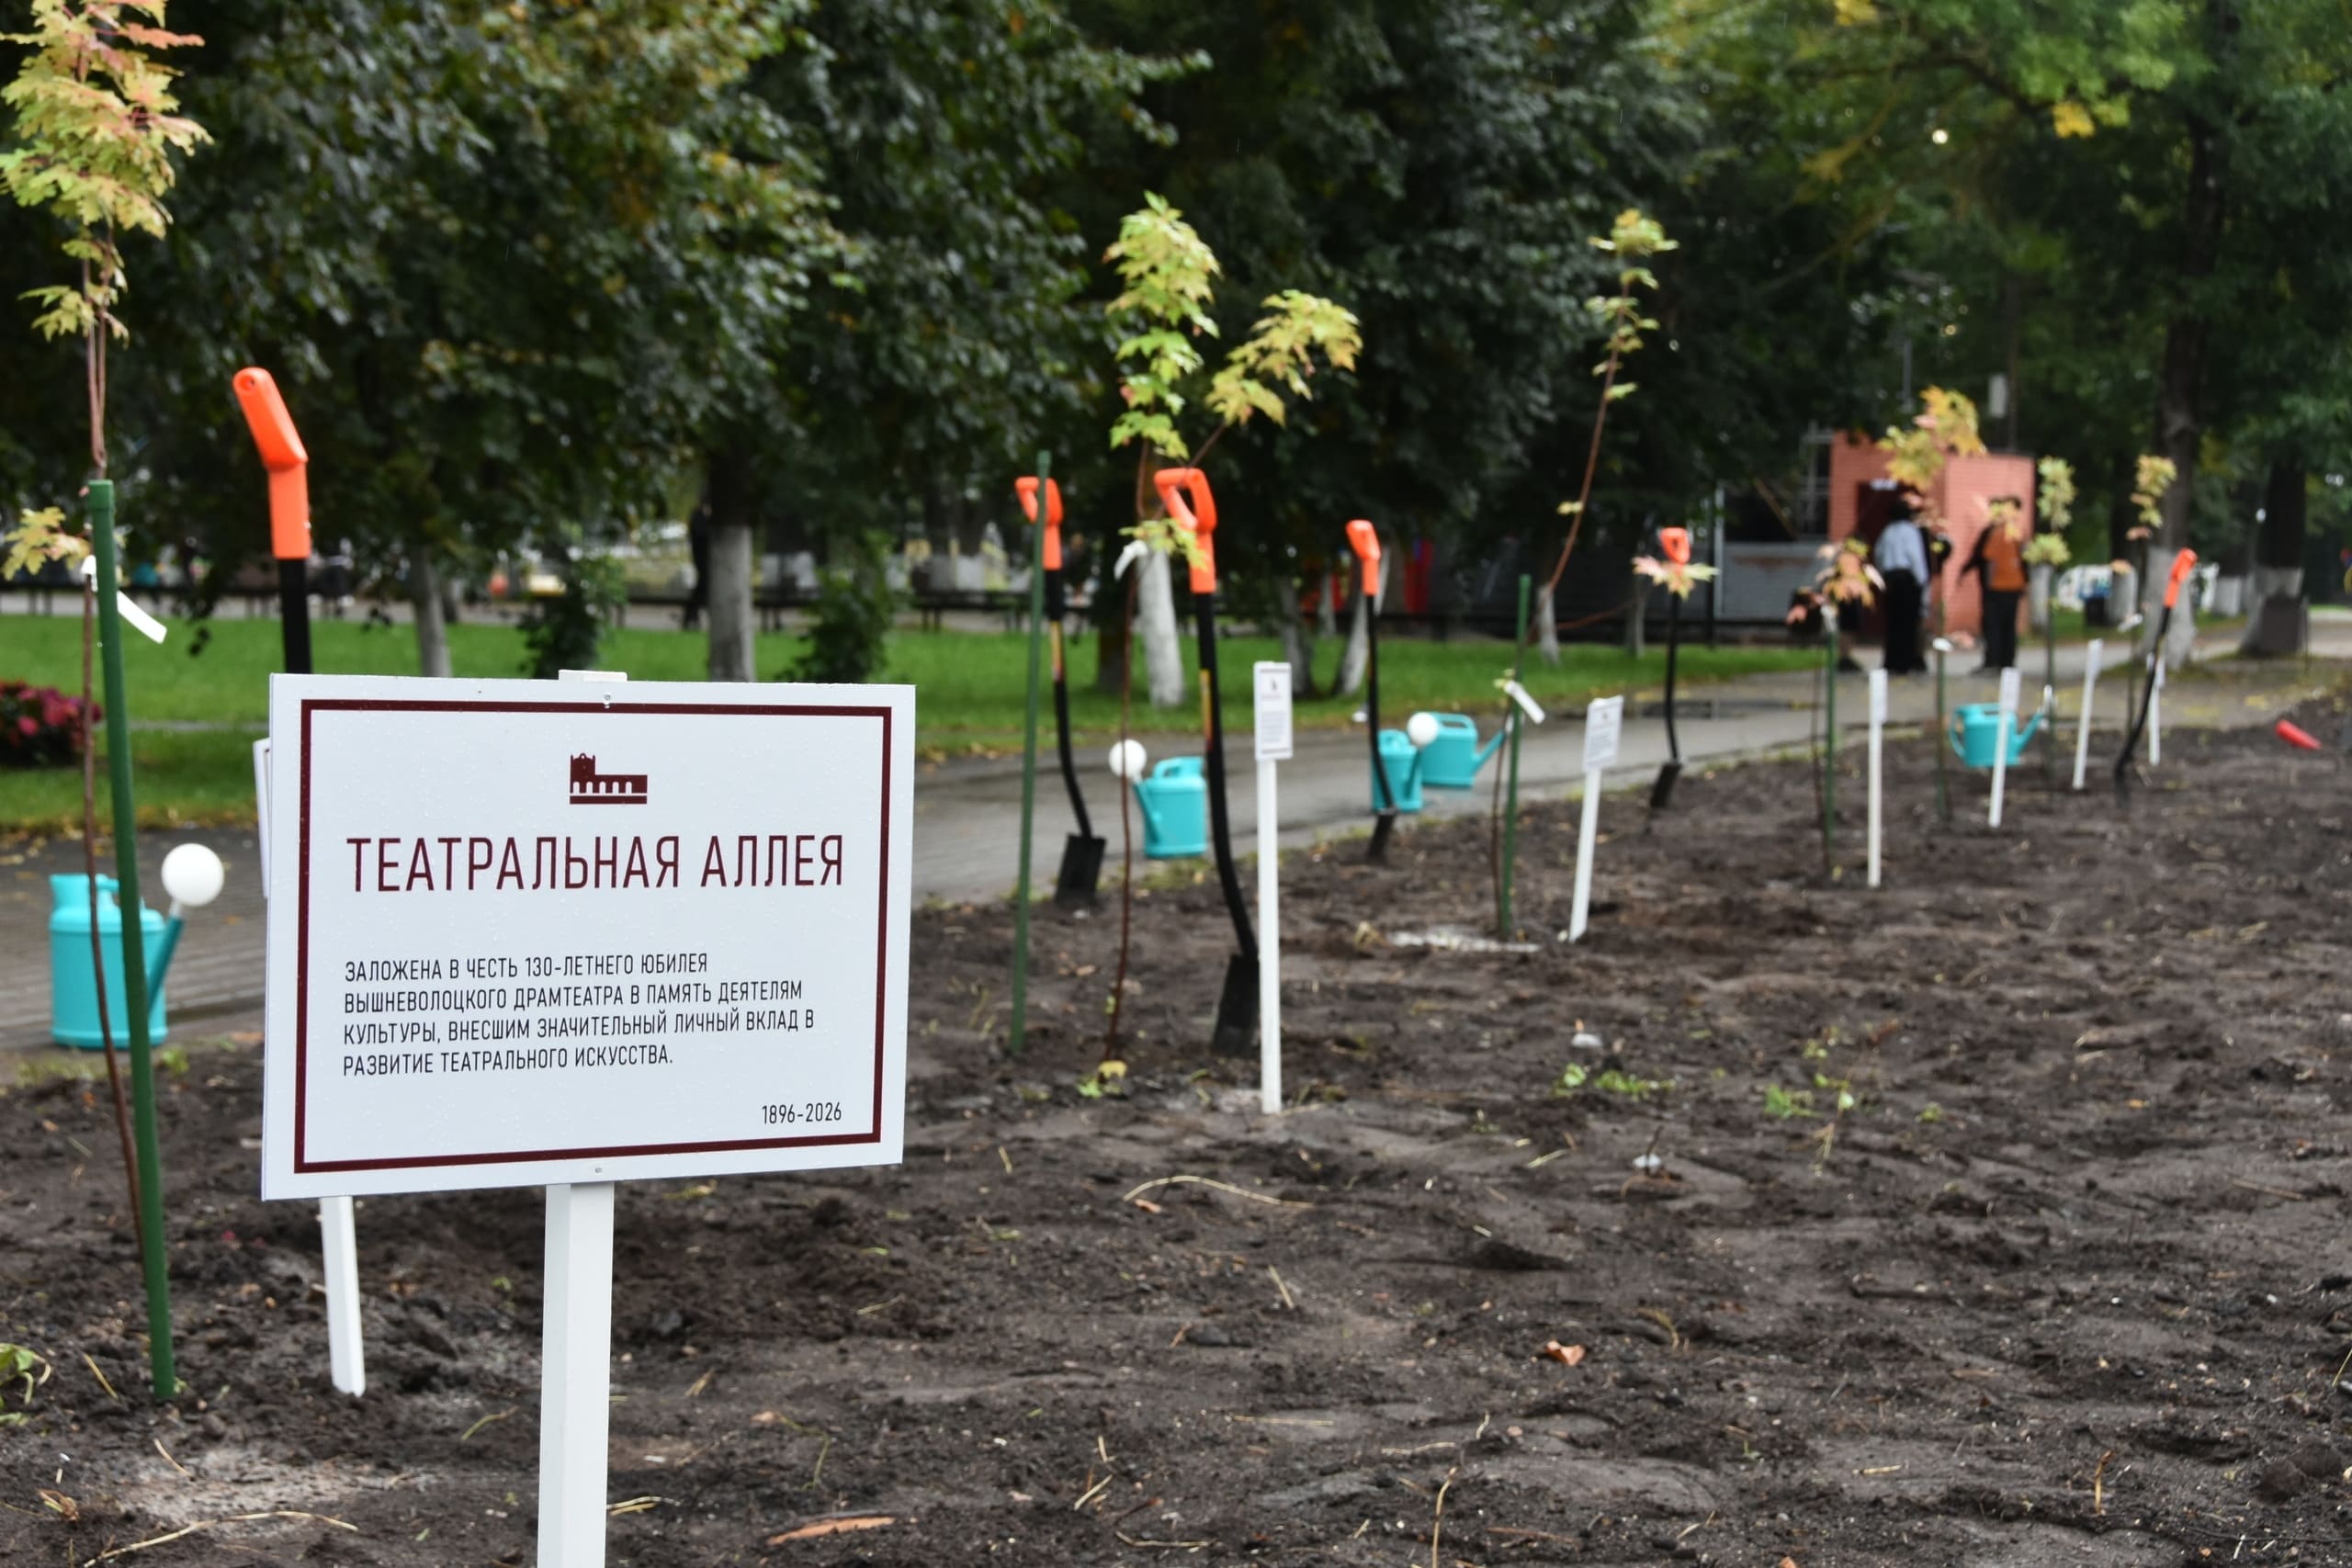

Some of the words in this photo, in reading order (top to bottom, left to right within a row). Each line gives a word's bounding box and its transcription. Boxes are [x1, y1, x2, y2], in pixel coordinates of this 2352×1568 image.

[345, 835, 680, 893] ТЕАТРАЛЬНАЯ
[700, 834, 842, 887] АЛЛЕЯ
[345, 959, 442, 983] ЗАЛОЖЕНА
[449, 958, 459, 979] В
[467, 957, 518, 978] ЧЕСТЬ
[525, 954, 634, 977] 130-ЛЕТНЕГО
[640, 953, 707, 975] ЮБИЛЕЯ
[345, 988, 507, 1014] ВЫШНЕВОЛОЦКОГО
[513, 985, 624, 1011] ДРАМТЕАТРА
[630, 985, 639, 1005] В
[647, 983, 712, 1004] ПАМЯТЬ
[718, 980, 802, 1005] ДЕЯТЕЛЯМ
[344, 1021, 441, 1045] КУЛЬТУРЫ,
[448, 1018, 530, 1042] ВНЕСШИМ
[537, 1009, 667, 1038] ЗНАЧИТЕЛЬНЫЙ
[673, 1011, 740, 1033] ЛИЧНЫЙ
[746, 1010, 798, 1032] ВКЛАД
[805, 1009, 814, 1029] В
[344, 1053, 434, 1077] РАЗВИТИЕ
[440, 1047, 568, 1073] ТЕАТРАЛЬНОГО
[575, 1043, 673, 1067] ИСКУССТВА.
[762, 1101, 842, 1125] 1896-2026
